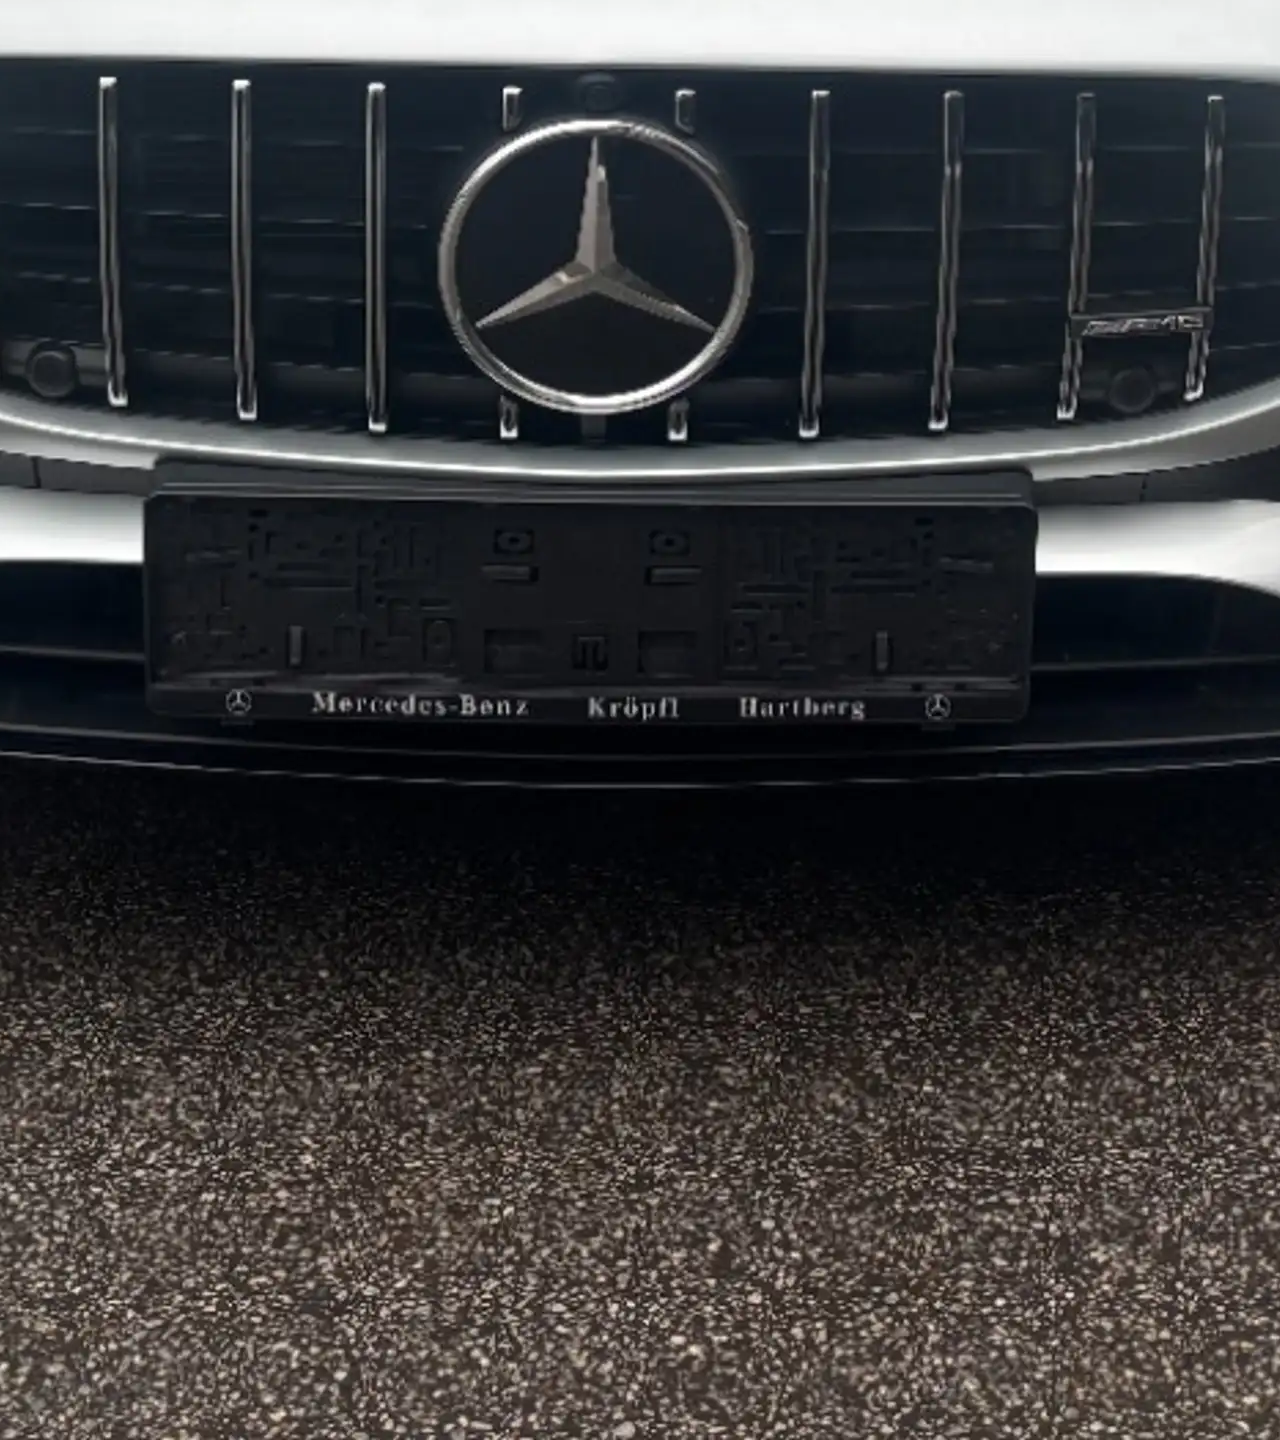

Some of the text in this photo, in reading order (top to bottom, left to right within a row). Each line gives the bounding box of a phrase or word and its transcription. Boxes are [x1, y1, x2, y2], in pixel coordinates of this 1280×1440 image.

[312, 690, 866, 722] Mercedes-Benz Kröpfl Hartberg
